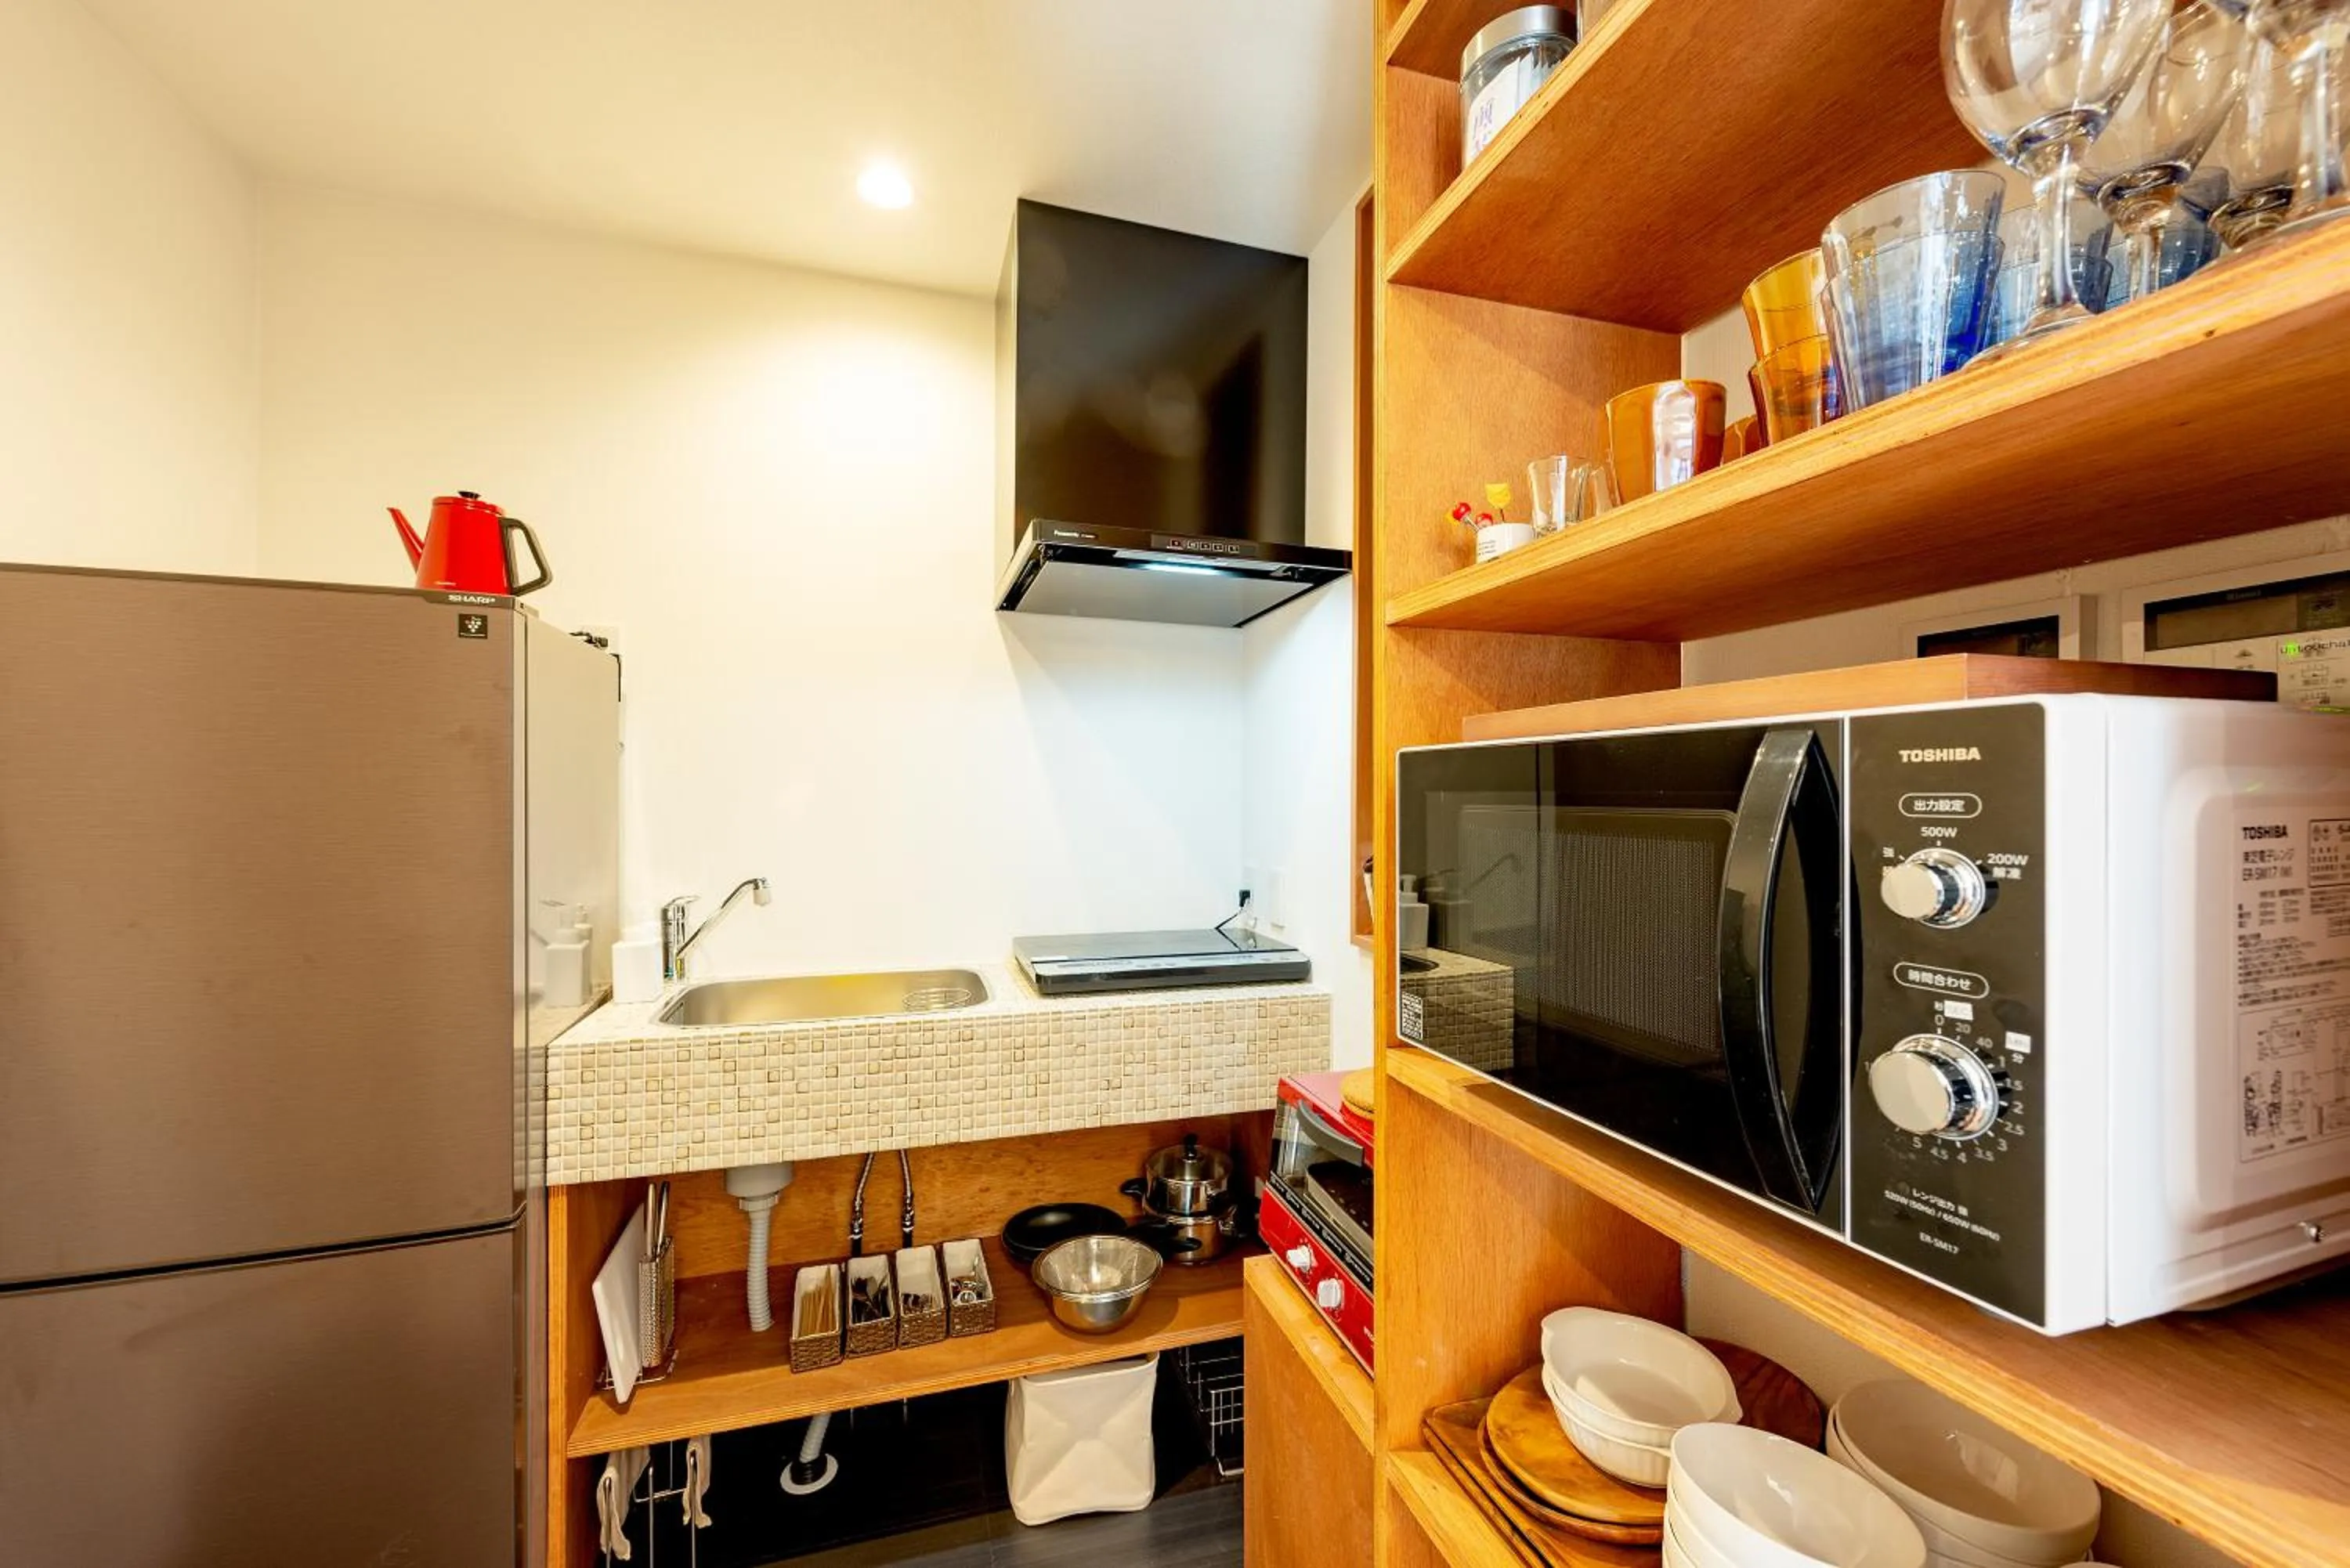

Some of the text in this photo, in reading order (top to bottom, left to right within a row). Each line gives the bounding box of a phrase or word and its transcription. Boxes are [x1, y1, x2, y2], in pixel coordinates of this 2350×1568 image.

[1900, 747, 1981, 763] TOSHIBA
[1914, 799, 1965, 812] 出力設定
[1921, 826, 1958, 837] 500W
[2241, 825, 2288, 840] TOSHIBA
[1987, 853, 2030, 865] 200W
[1907, 969, 1972, 991] 時間合わせ
[1954, 1022, 1971, 1034] 20
[1976, 1037, 1994, 1049] 40
[2012, 1102, 2024, 1115] 2
[1912, 1136, 1923, 1149] 5
[1997, 1139, 2008, 1151] 3
[1957, 1152, 1968, 1164] 4
